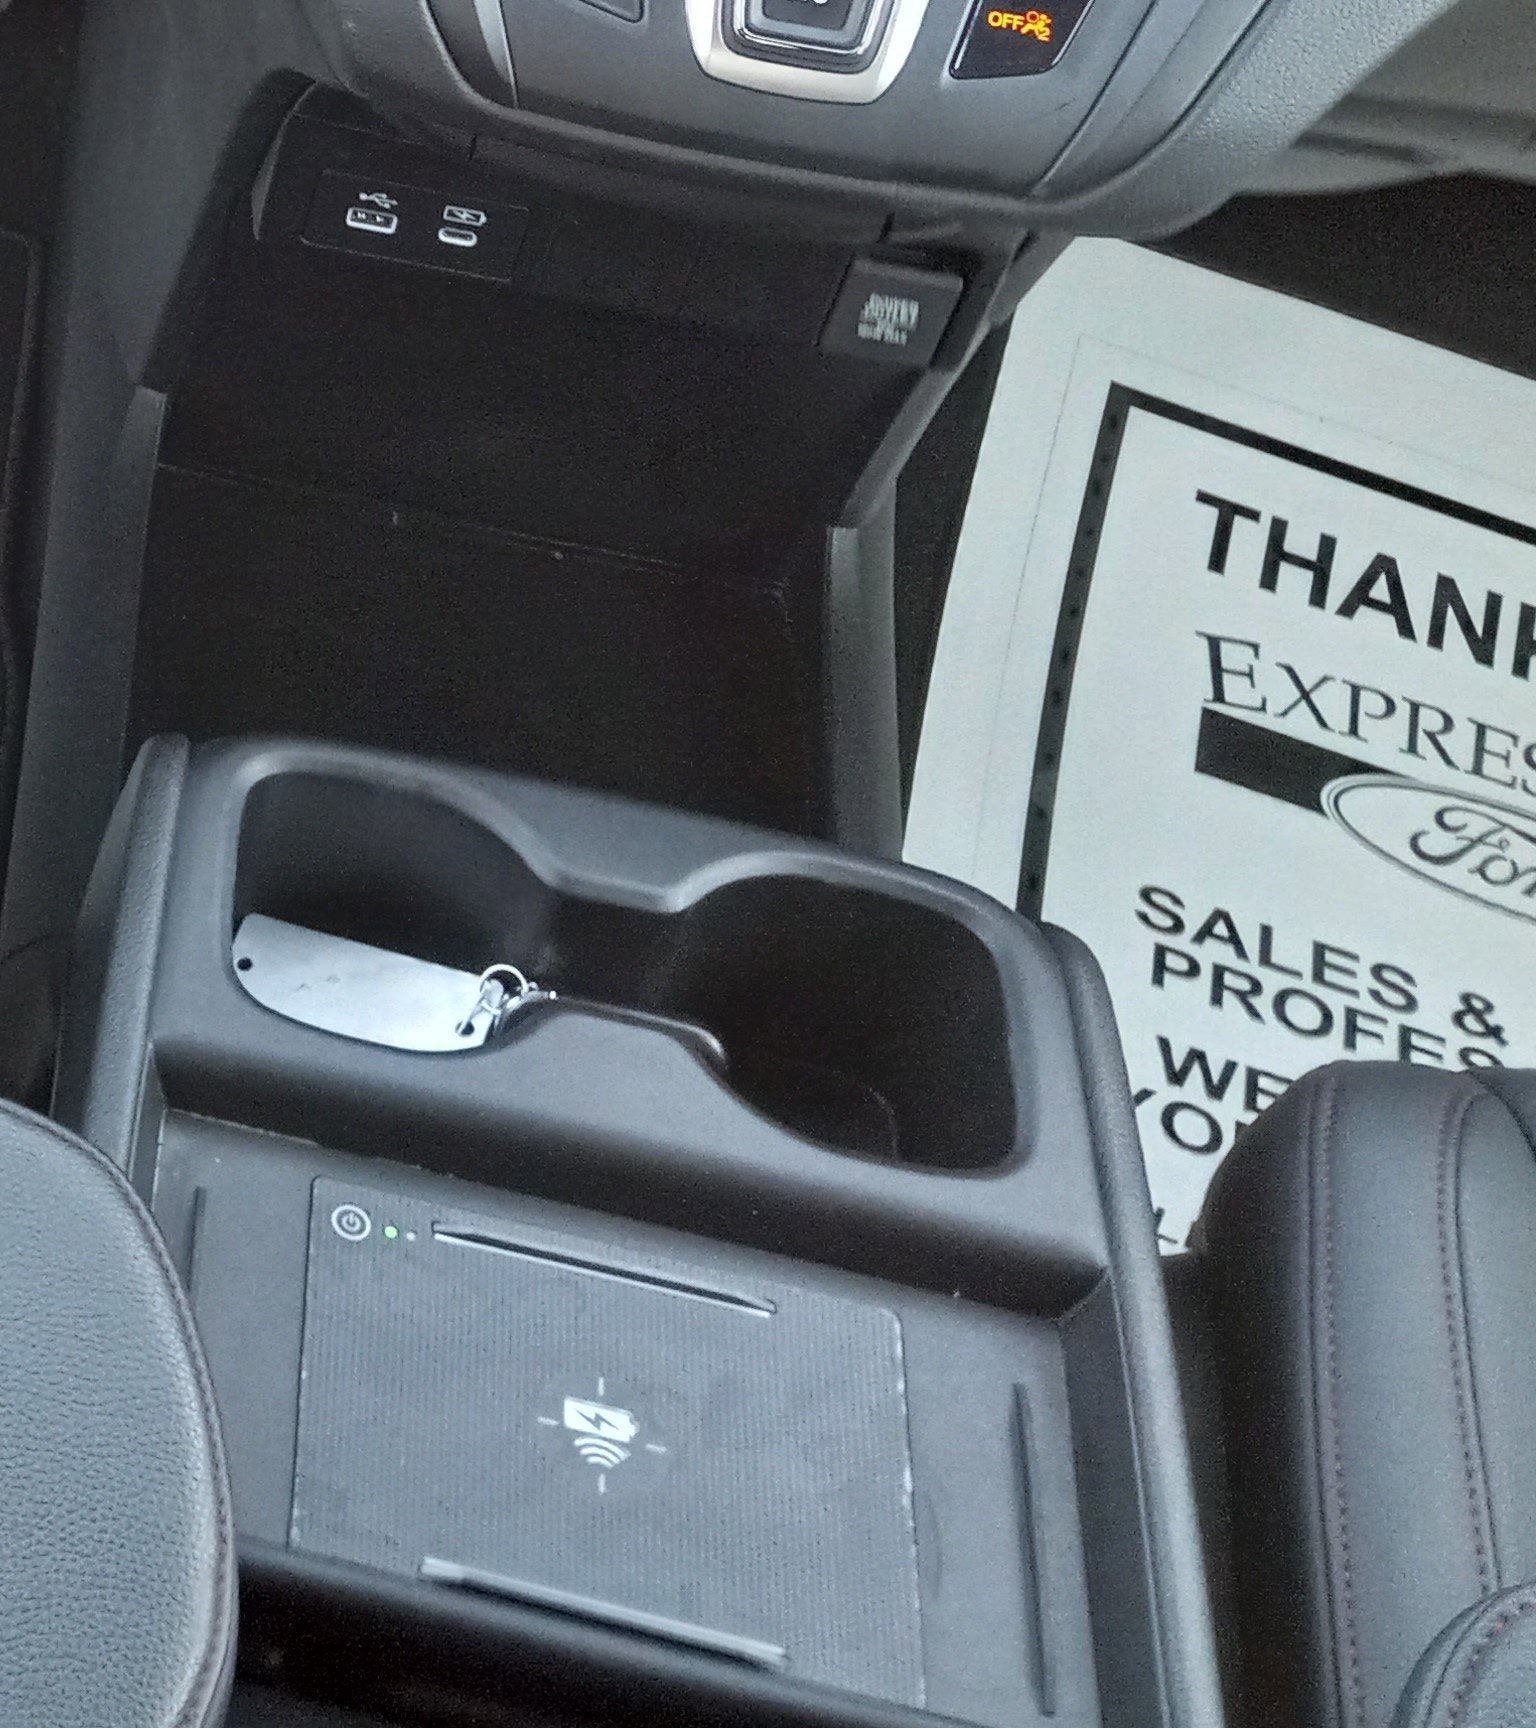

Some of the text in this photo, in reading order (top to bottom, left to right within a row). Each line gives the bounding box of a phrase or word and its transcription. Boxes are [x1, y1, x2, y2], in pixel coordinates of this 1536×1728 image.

[988, 11, 1025, 30] OFF
[1135, 883, 1508, 1046] SALES &
